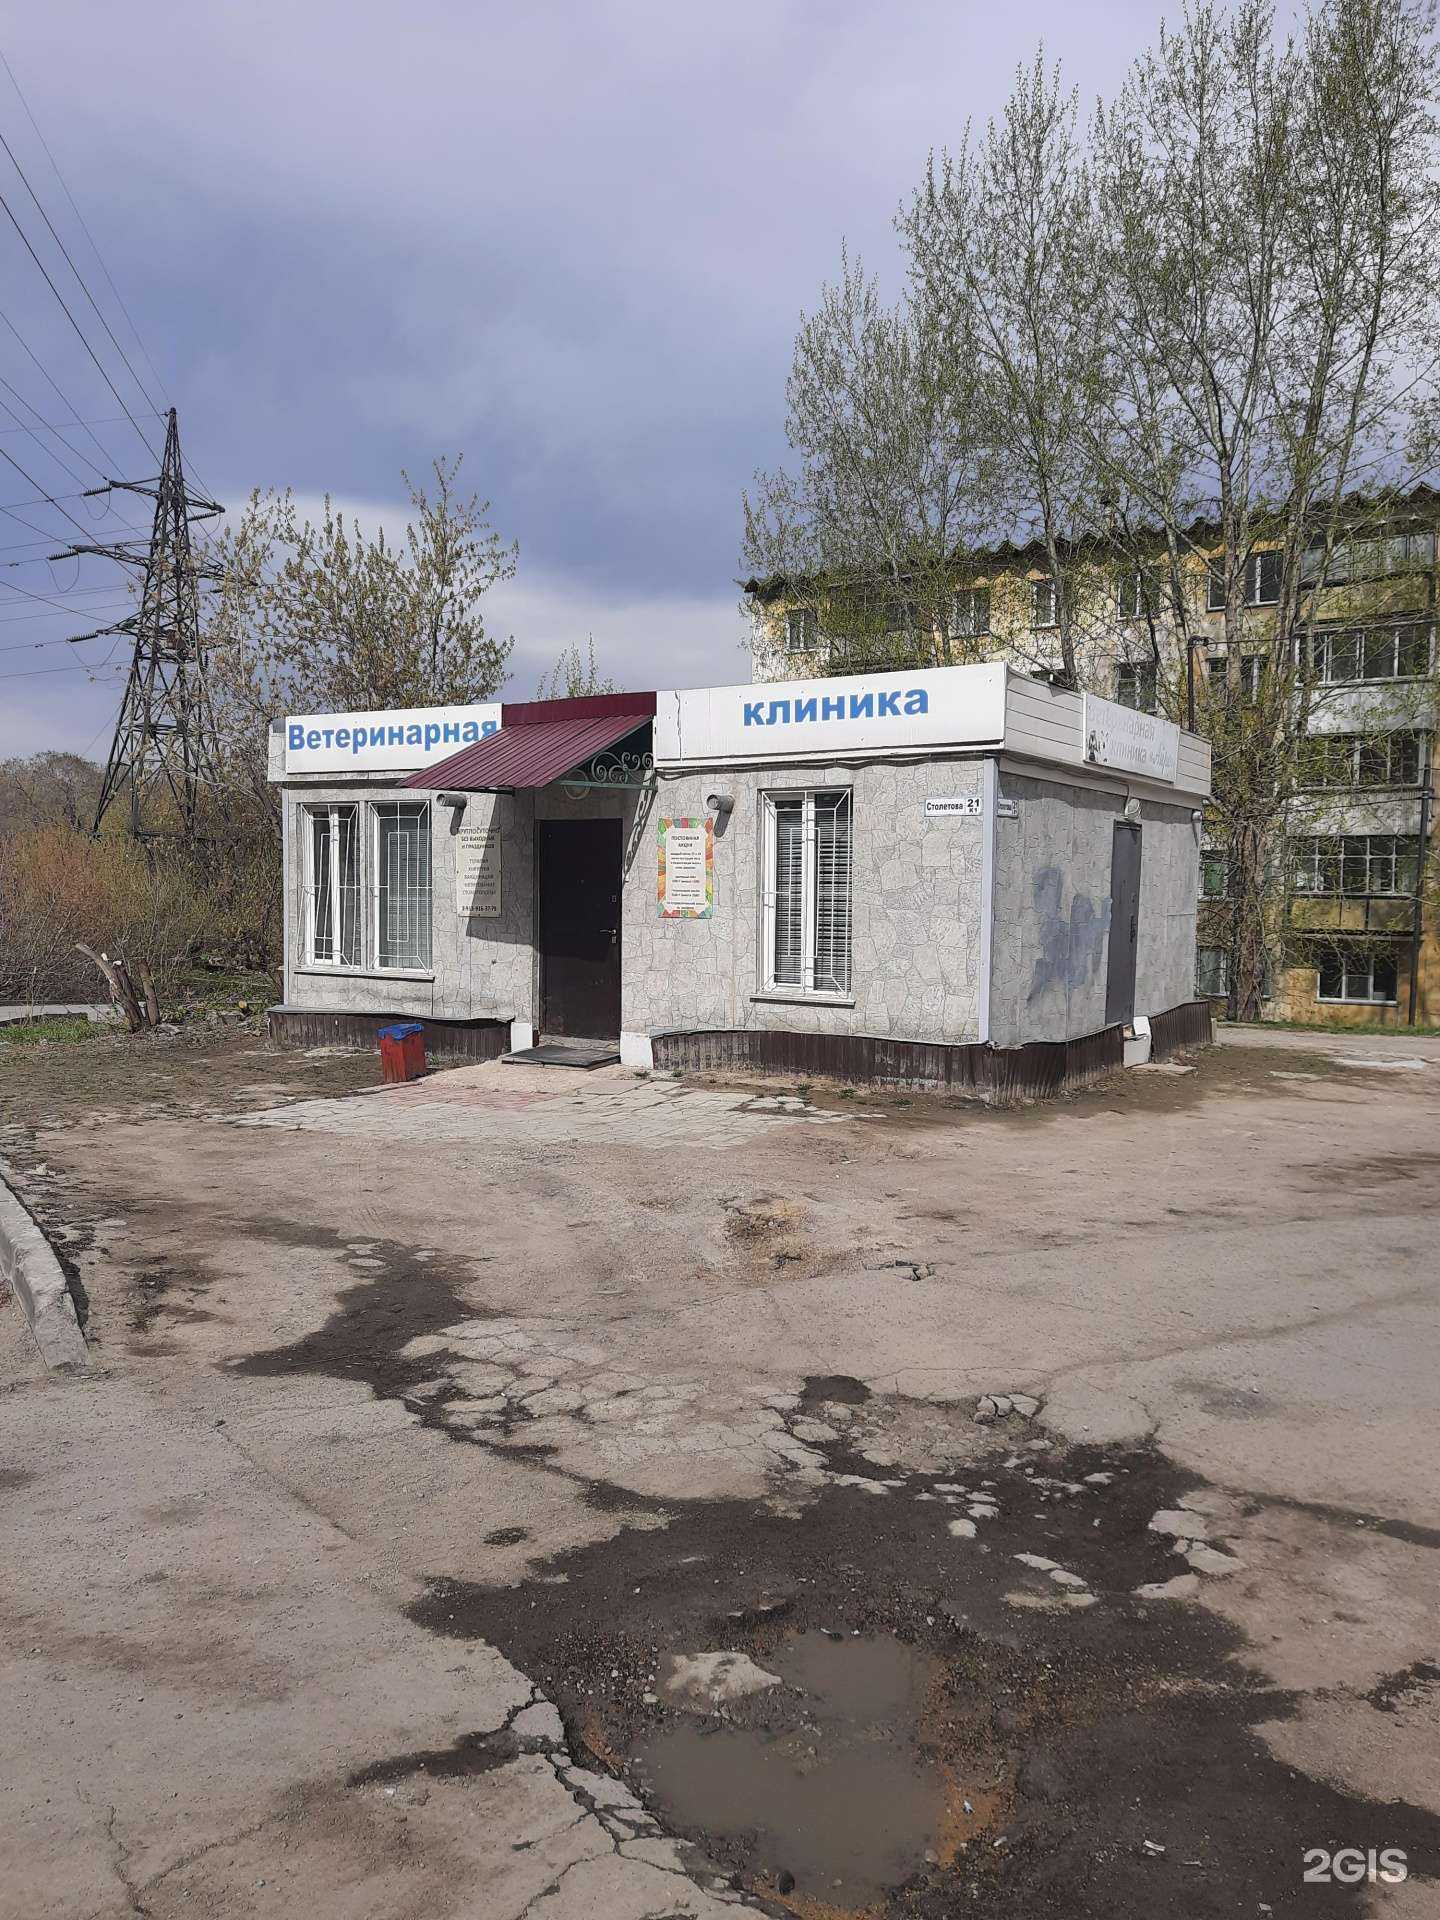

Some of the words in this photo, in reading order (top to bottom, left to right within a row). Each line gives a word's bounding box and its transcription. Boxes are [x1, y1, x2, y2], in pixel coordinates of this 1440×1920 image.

[743, 688, 929, 727] клиника
[288, 720, 498, 754] Ветеринарная
[926, 802, 964, 811] Столетова
[967, 798, 980, 808] 21
